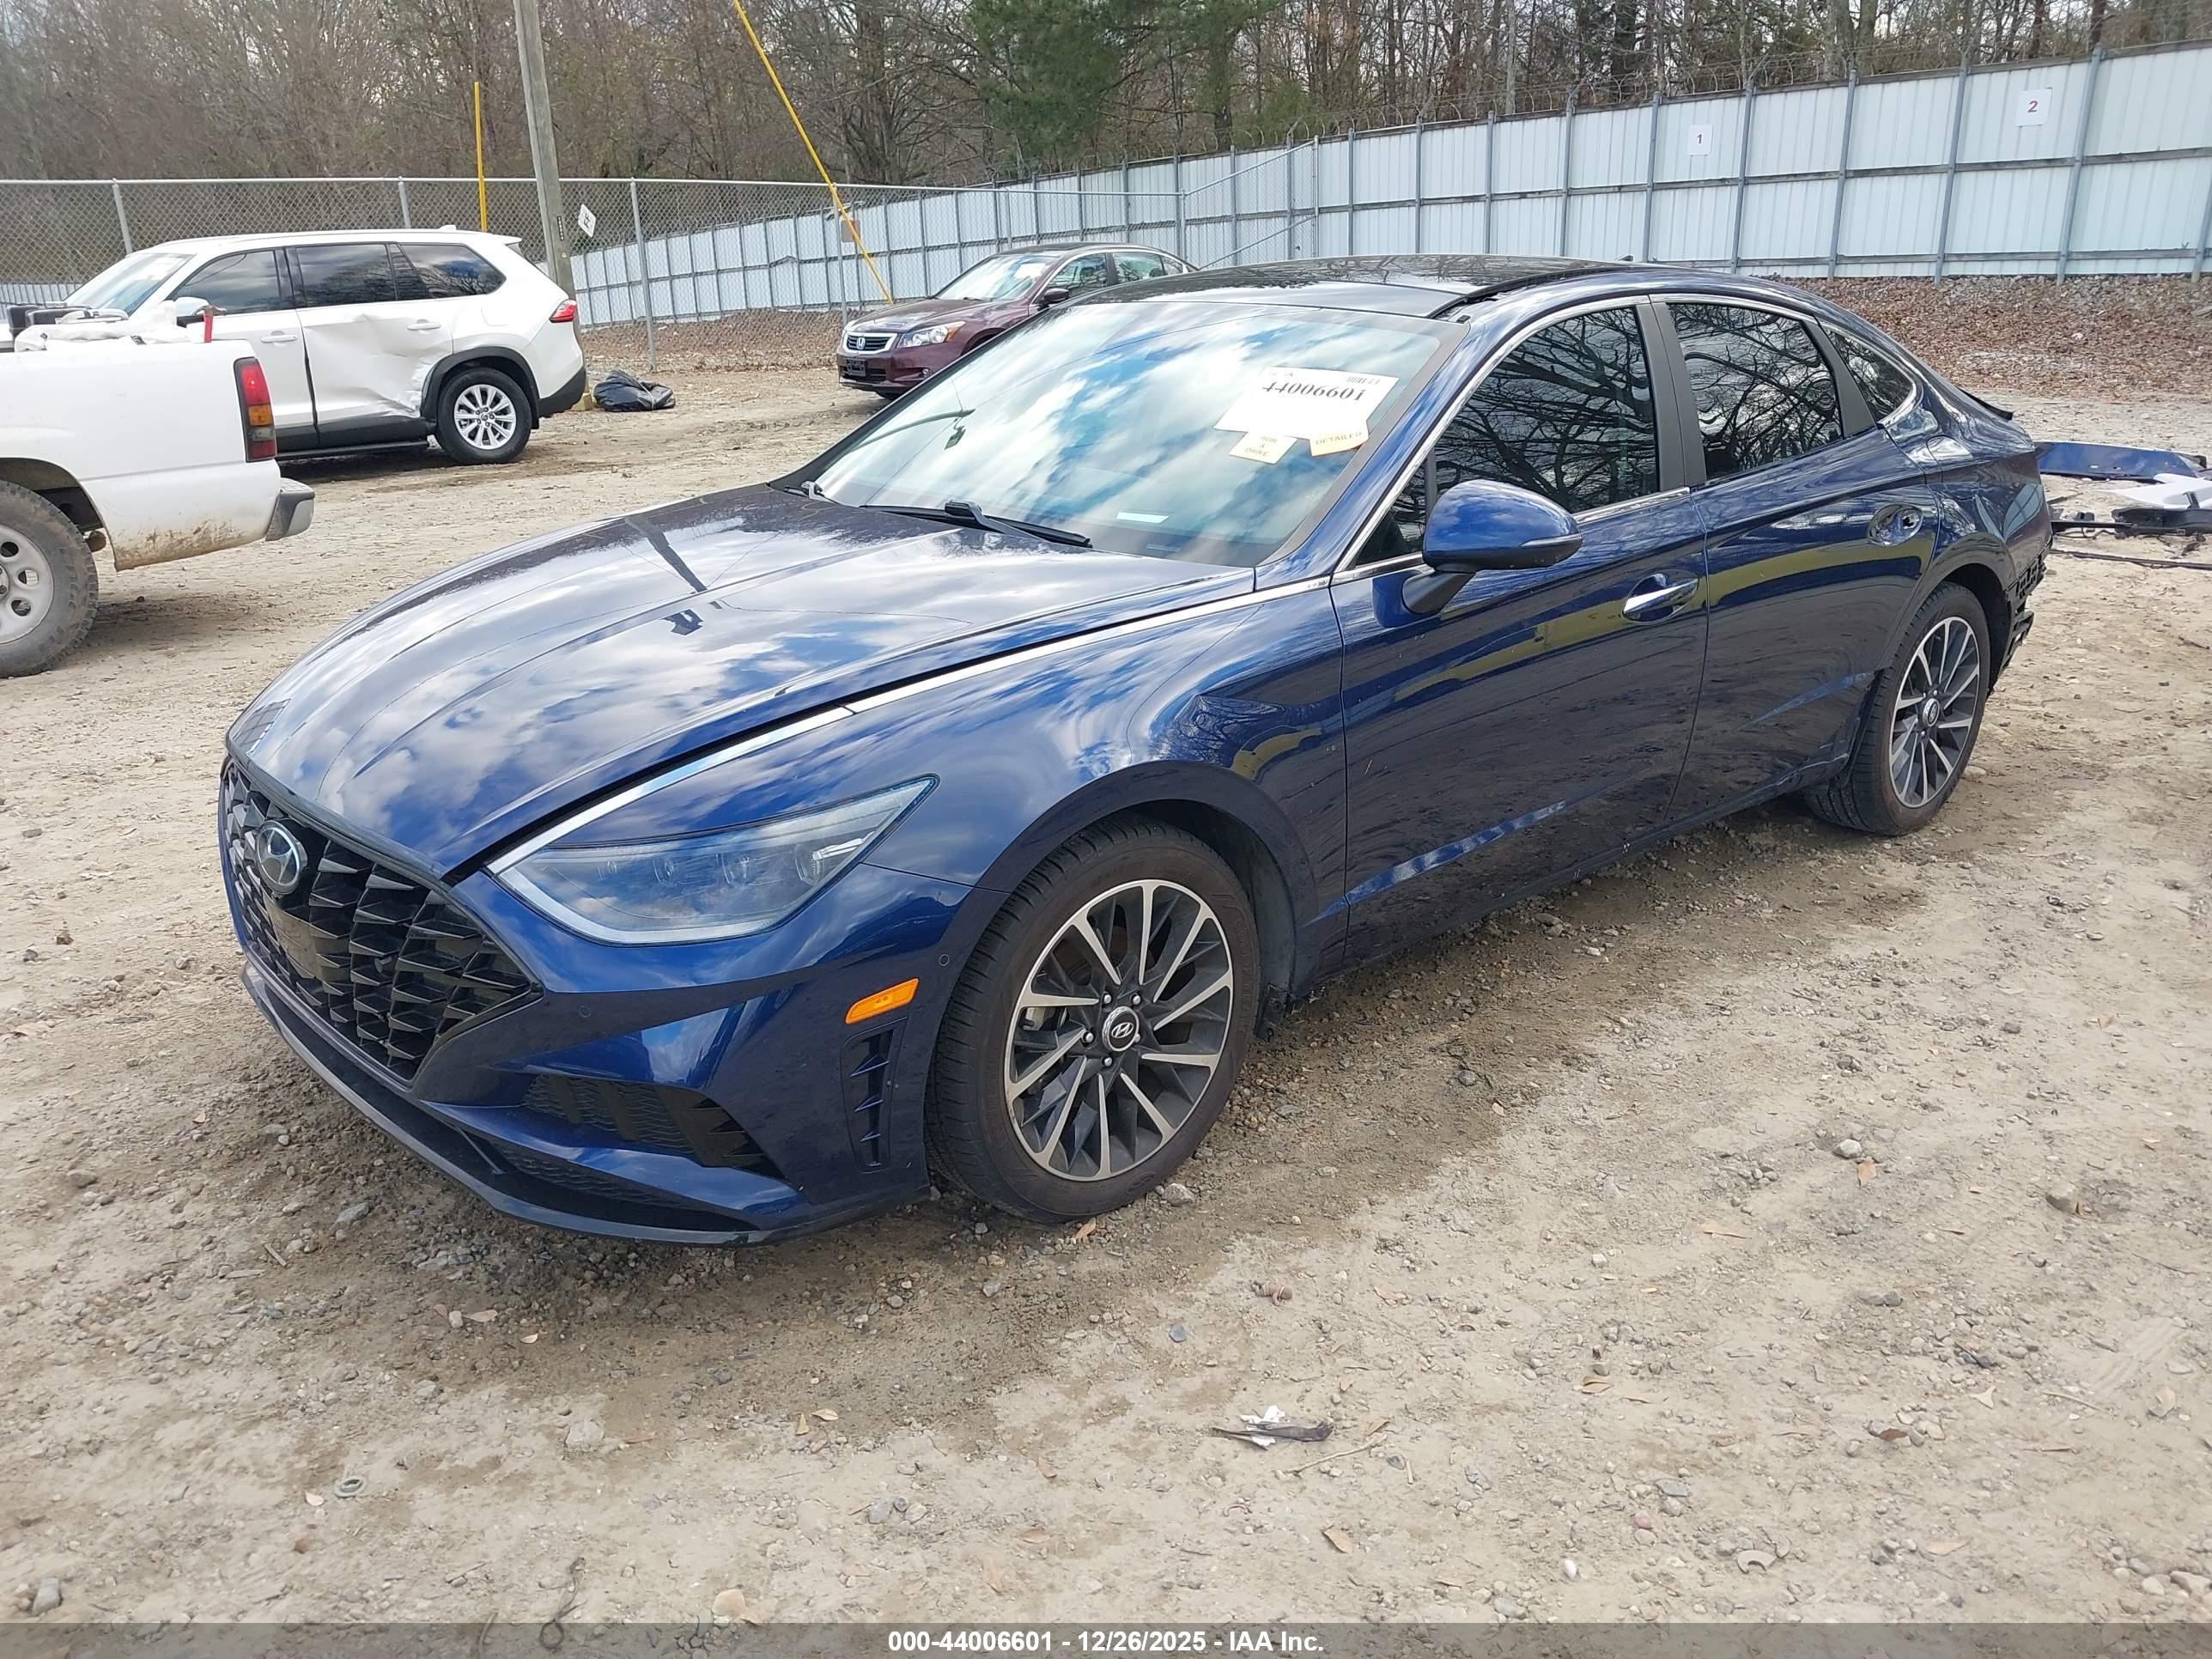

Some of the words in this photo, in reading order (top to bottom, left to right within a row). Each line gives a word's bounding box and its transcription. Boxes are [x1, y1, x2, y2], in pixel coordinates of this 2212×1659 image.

[2027, 100, 2039, 113] 2
[1696, 133, 1703, 144] 1
[1262, 381, 1366, 401] 44006601
